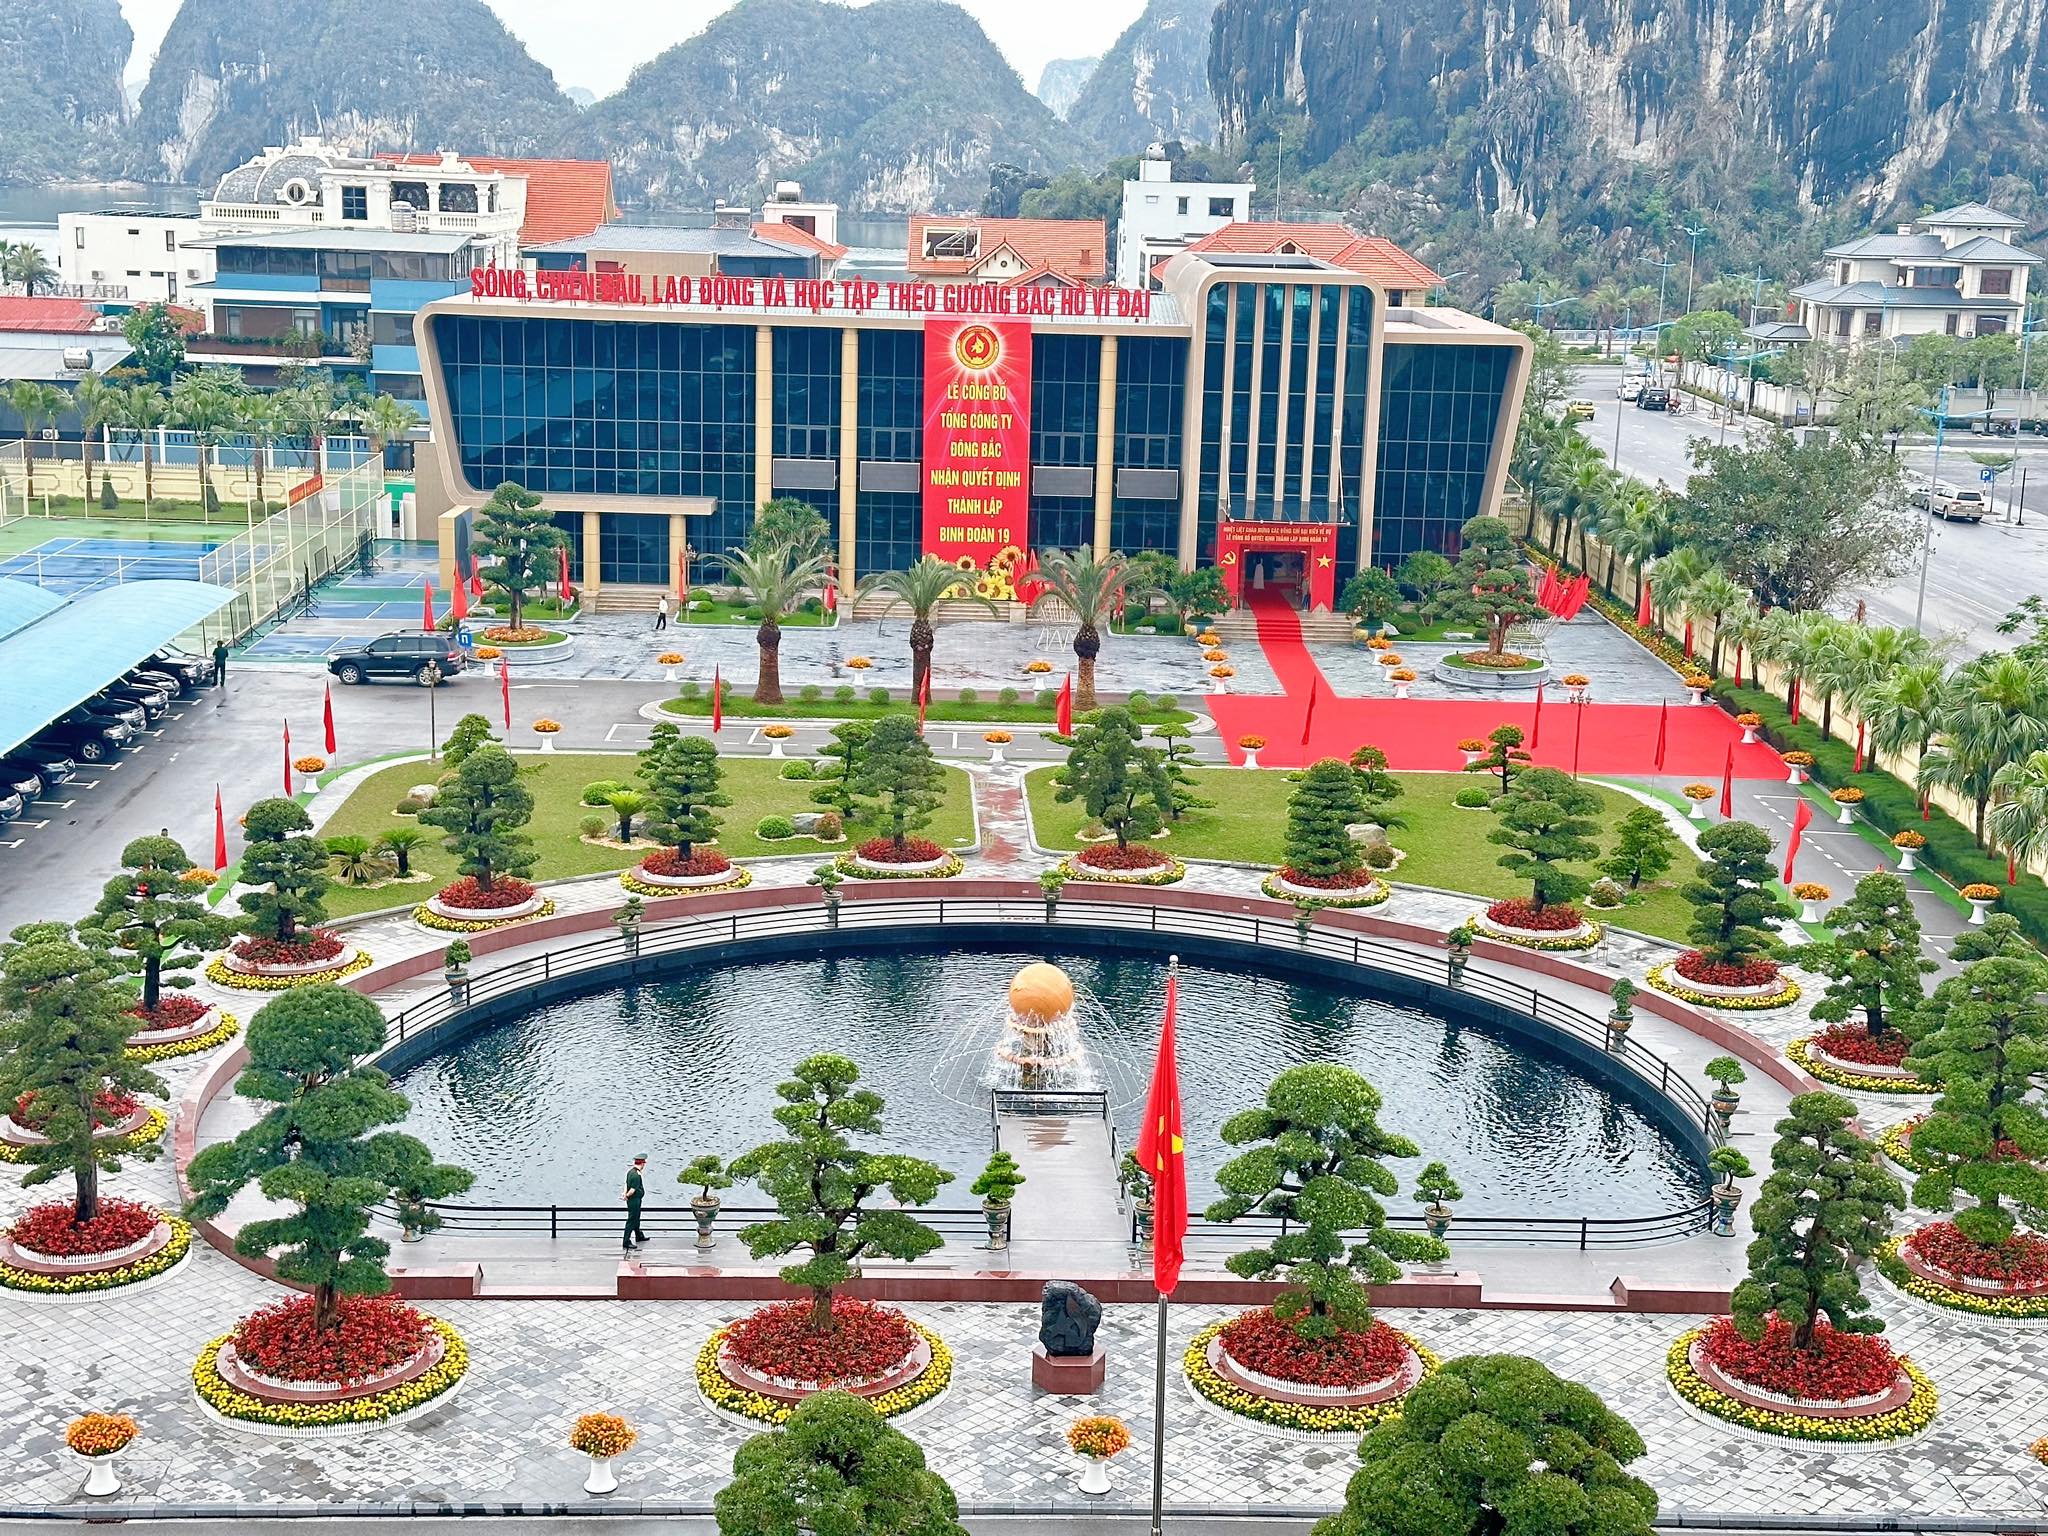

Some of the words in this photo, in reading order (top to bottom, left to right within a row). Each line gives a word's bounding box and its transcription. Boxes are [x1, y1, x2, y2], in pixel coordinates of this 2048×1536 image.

[470, 256, 532, 302] SỐNG,
[652, 275, 692, 304] LAO
[699, 270, 755, 311] ĐỘNG
[762, 272, 788, 307] VÀ
[794, 279, 834, 315] HỌC
[841, 274, 878, 315] TẬP
[886, 281, 936, 311] THEO
[943, 282, 1011, 315] GƯƠNG
[1117, 289, 1151, 322] ĐẠI
[948, 378, 959, 400] LỄ
[962, 381, 990, 400] CÔNG
[993, 380, 1007, 400] BỐ
[940, 407, 967, 428] TỔNG
[970, 410, 998, 429] CÔNG
[1001, 414, 1013, 429] TY
[950, 438, 978, 457] ĐÔNG
[981, 436, 1002, 458] BẮC
[930, 467, 959, 488] NHẬN
[962, 466, 993, 487] QUYẾT
[996, 471, 1020, 489] ĐỊNH
[1982, 470, 1990, 479] P
[948, 495, 980, 514] THÀNH
[983, 496, 1003, 518] LẬP
[940, 526, 964, 542] BINH
[967, 524, 995, 543] ĐOÀN
[998, 528, 1010, 543] 19
